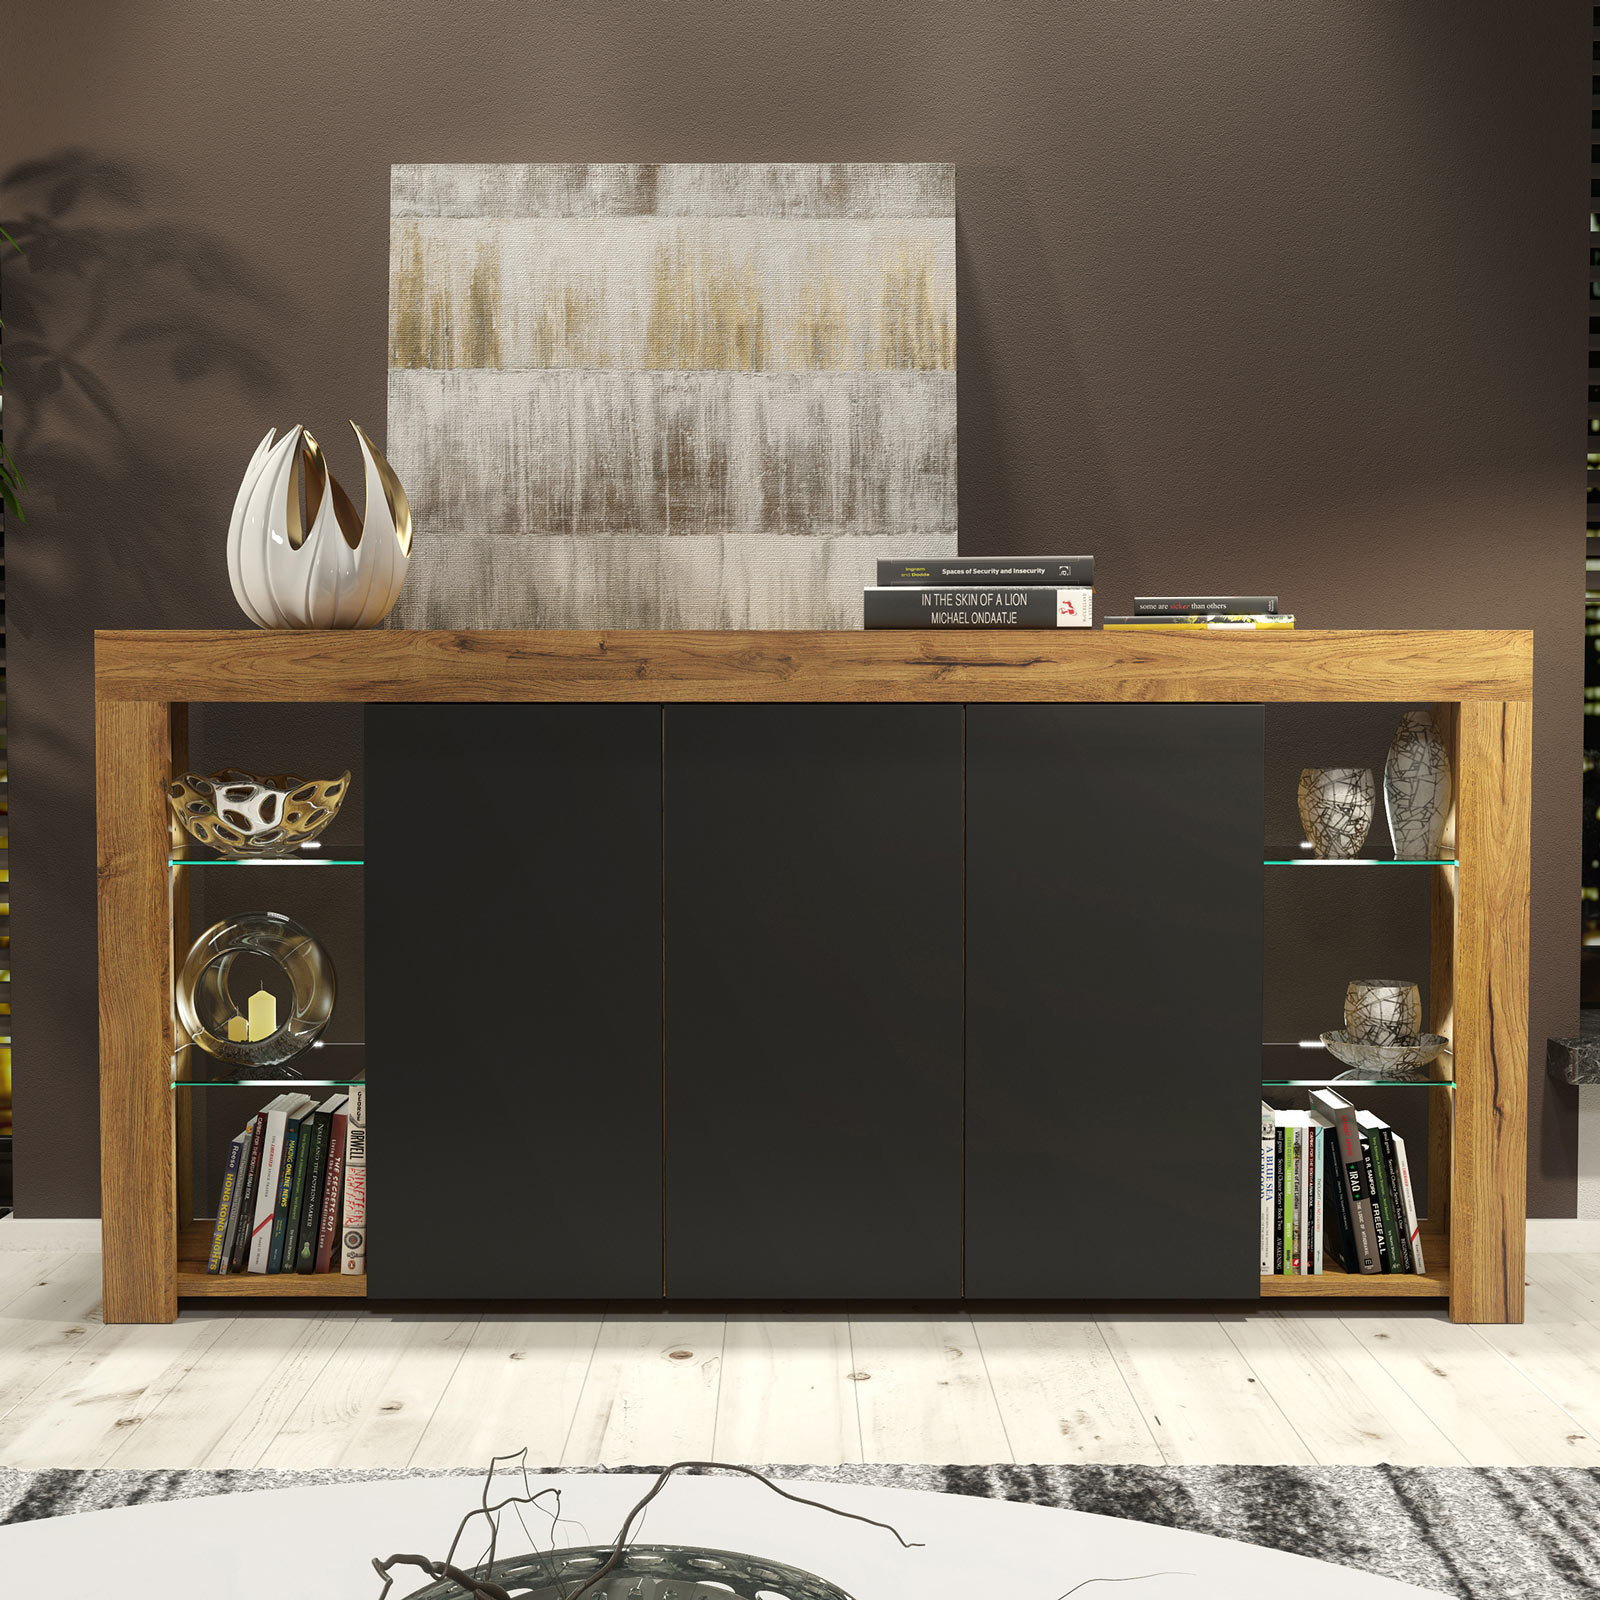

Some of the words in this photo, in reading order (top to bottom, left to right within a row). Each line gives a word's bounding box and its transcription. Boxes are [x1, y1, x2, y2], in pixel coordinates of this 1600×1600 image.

[922, 593, 932, 606] IN
[934, 593, 952, 606] THE
[955, 593, 978, 606] SKIN
[980, 593, 994, 606] OF
[996, 593, 1004, 606] A
[1004, 593, 1028, 606] LION
[932, 612, 970, 624] MICHAEL
[971, 612, 1017, 624] ONDAATJE
[228, 1145, 238, 1168] Reese
[286, 1139, 295, 1163] MAKING
[350, 1130, 364, 1160] ORWELL
[282, 1163, 292, 1188] ONLINE
[332, 1156, 340, 1173] THE
[221, 1172, 233, 1201] HONG
[308, 1175, 317, 1202] POTION
[1348, 1170, 1360, 1192] IRAQ
[1366, 1169, 1376, 1195] SANFORD
[280, 1188, 288, 1207] NEWS
[328, 1175, 338, 1213] SECRETS
[216, 1203, 228, 1232] KONG
[306, 1203, 314, 1227] MAKER
[326, 1215, 334, 1232] OUT
[1371, 1202, 1386, 1255] FREEFALL
[208, 1233, 222, 1270] NIGHTS
[1400, 1237, 1410, 1269] BEGINNINGS
